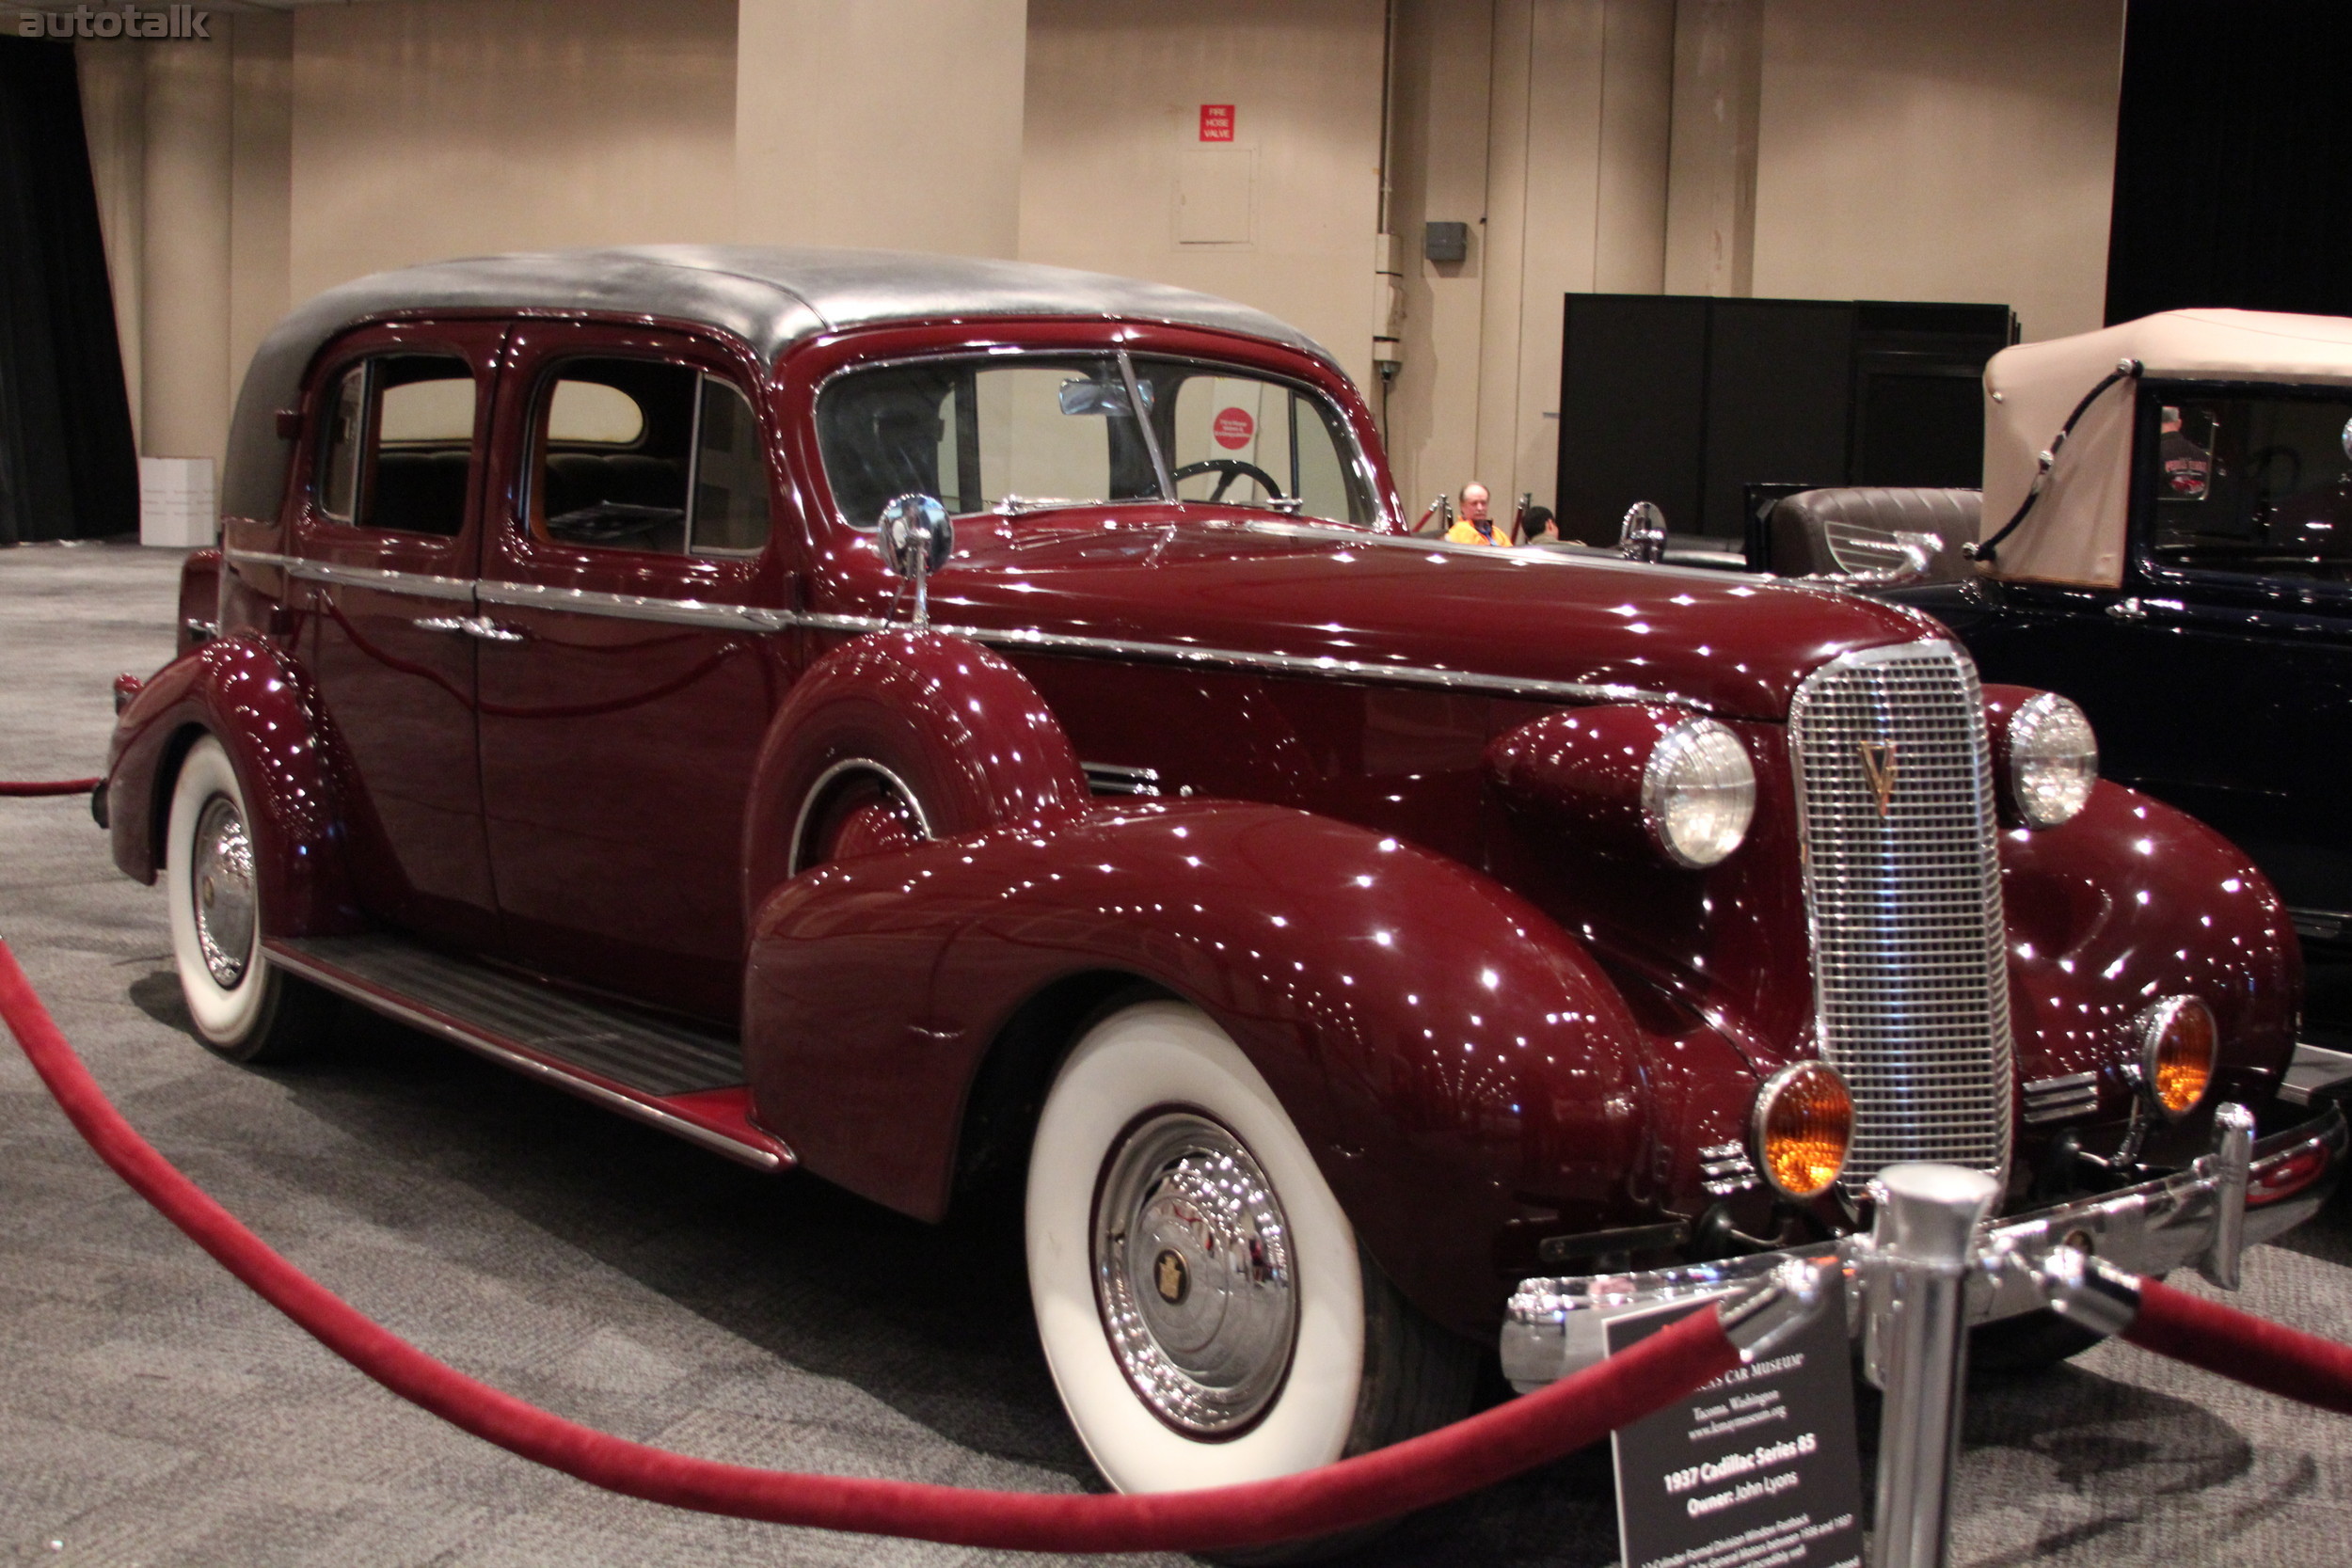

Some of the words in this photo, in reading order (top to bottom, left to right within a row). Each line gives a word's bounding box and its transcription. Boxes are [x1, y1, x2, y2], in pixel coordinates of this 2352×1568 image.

[1208, 108, 1227, 117] FIRE
[1206, 119, 1229, 128] HOSE
[1204, 129, 1231, 138] VALVE
[1724, 1368, 1749, 1385] CAR
[1663, 1466, 1700, 1493] 1937
[1700, 1453, 1756, 1483] Cadillac
[1755, 1440, 1798, 1467] Series
[1687, 1490, 1735, 1517] Owner:
[1735, 1481, 1764, 1502] John
[1763, 1470, 1799, 1496] Lyons
